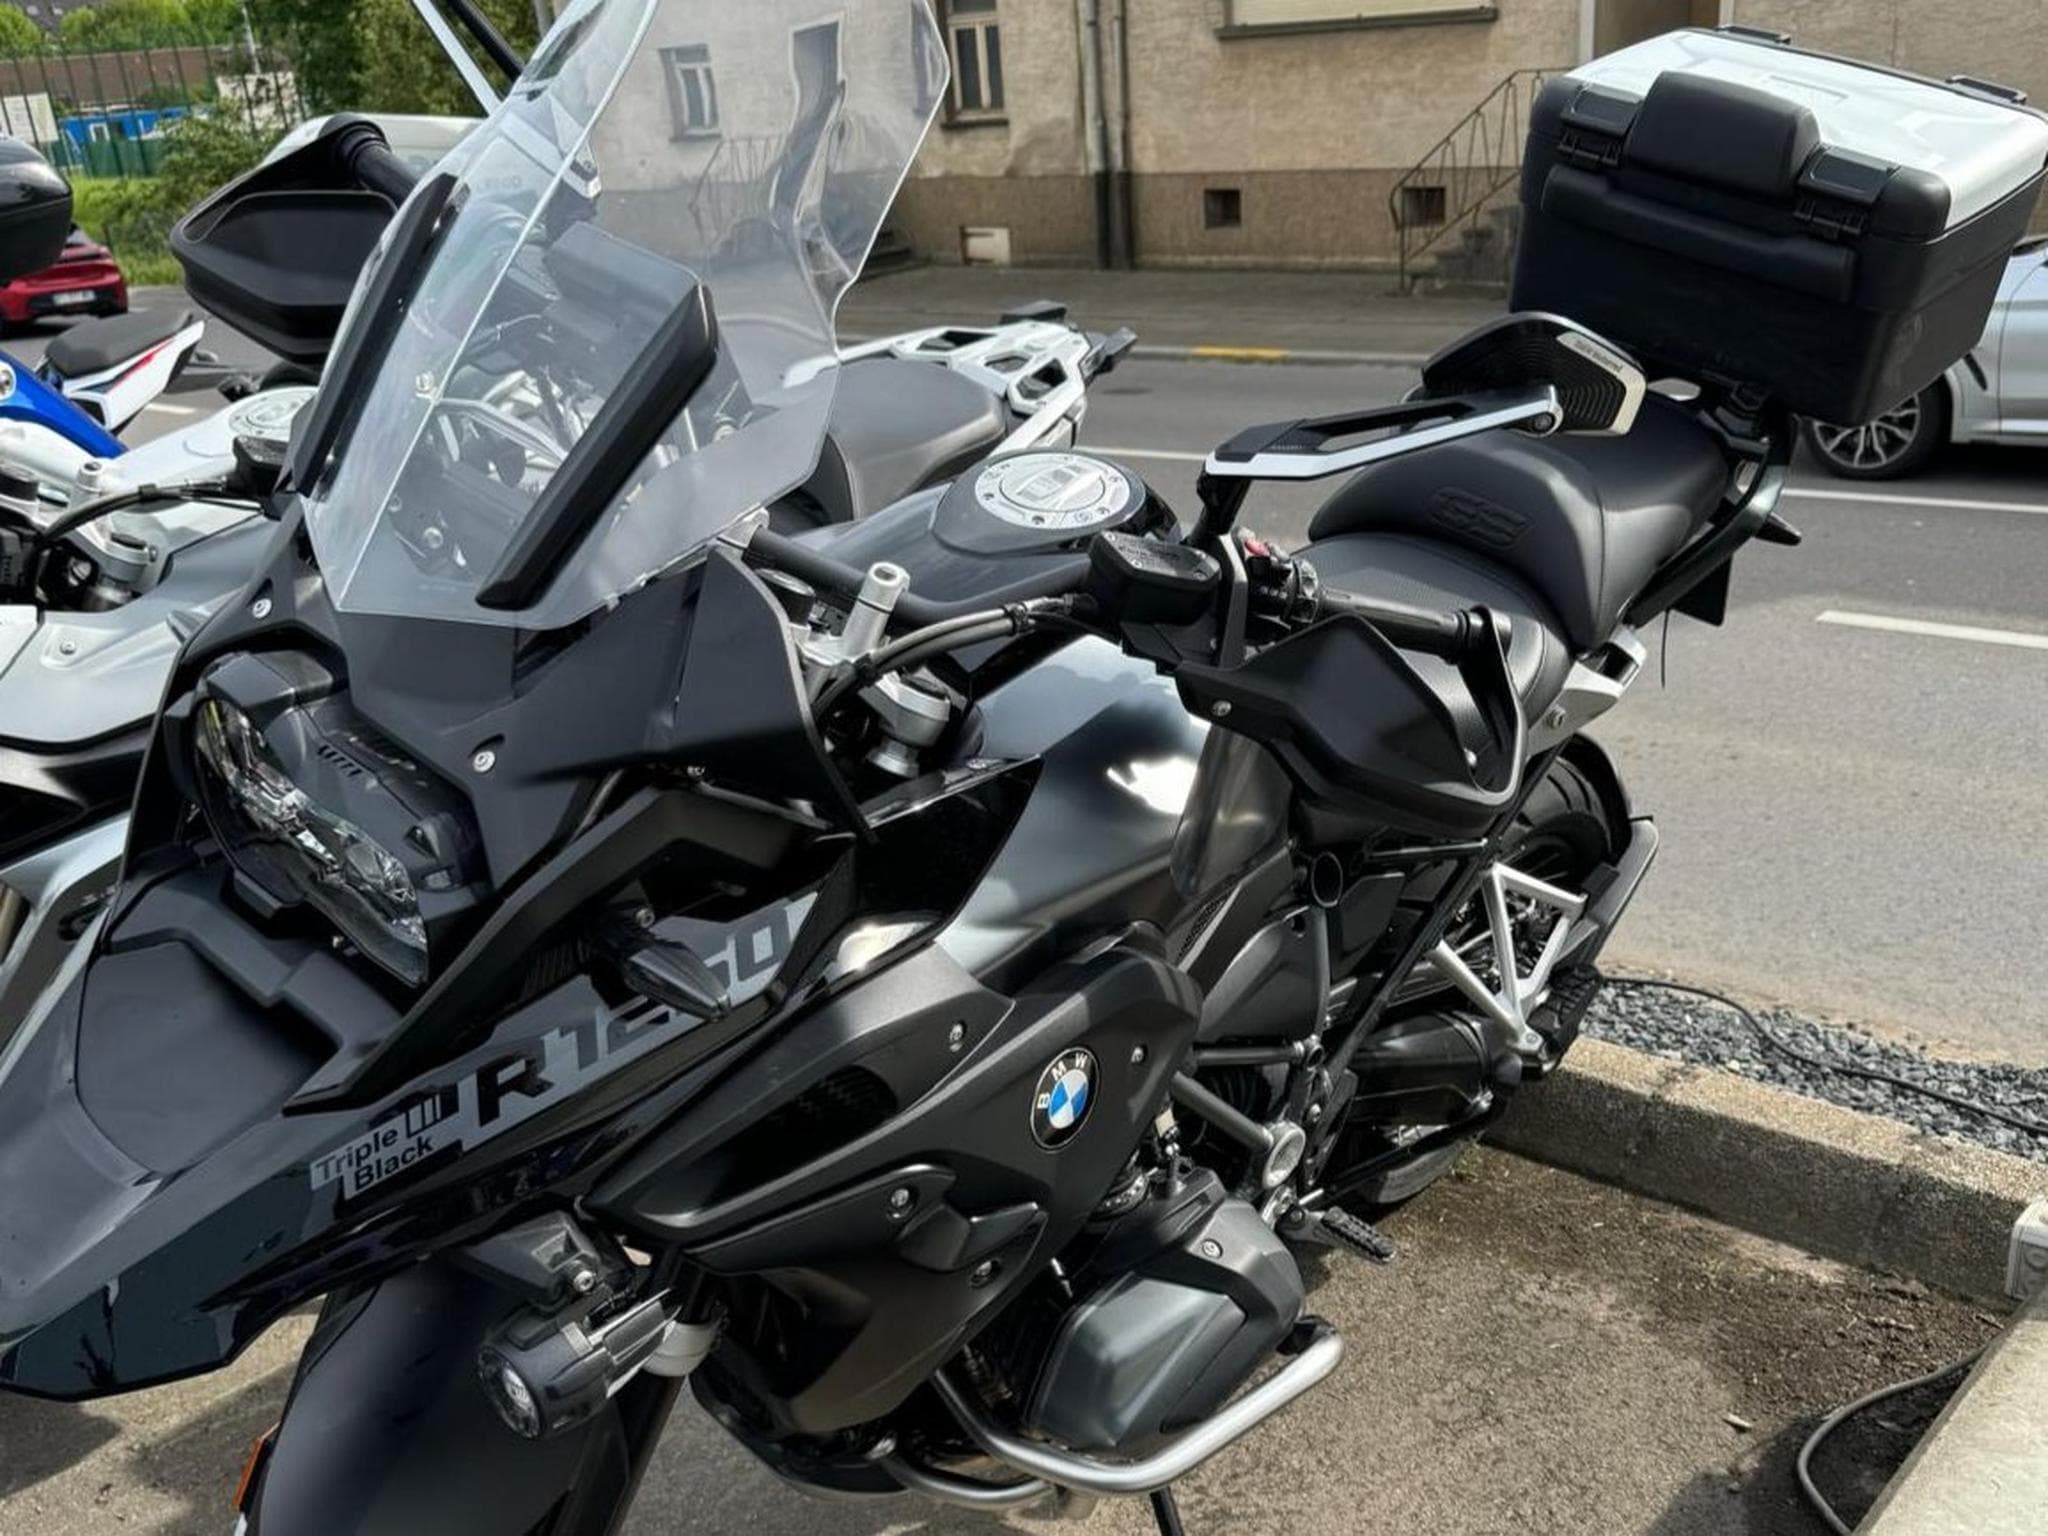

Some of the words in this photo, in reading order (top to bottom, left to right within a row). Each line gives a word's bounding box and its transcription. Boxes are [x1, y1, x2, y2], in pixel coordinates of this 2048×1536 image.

[1037, 1052, 1088, 1109] BMW
[316, 1127, 399, 1181] Triple
[354, 1136, 433, 1192] Black
